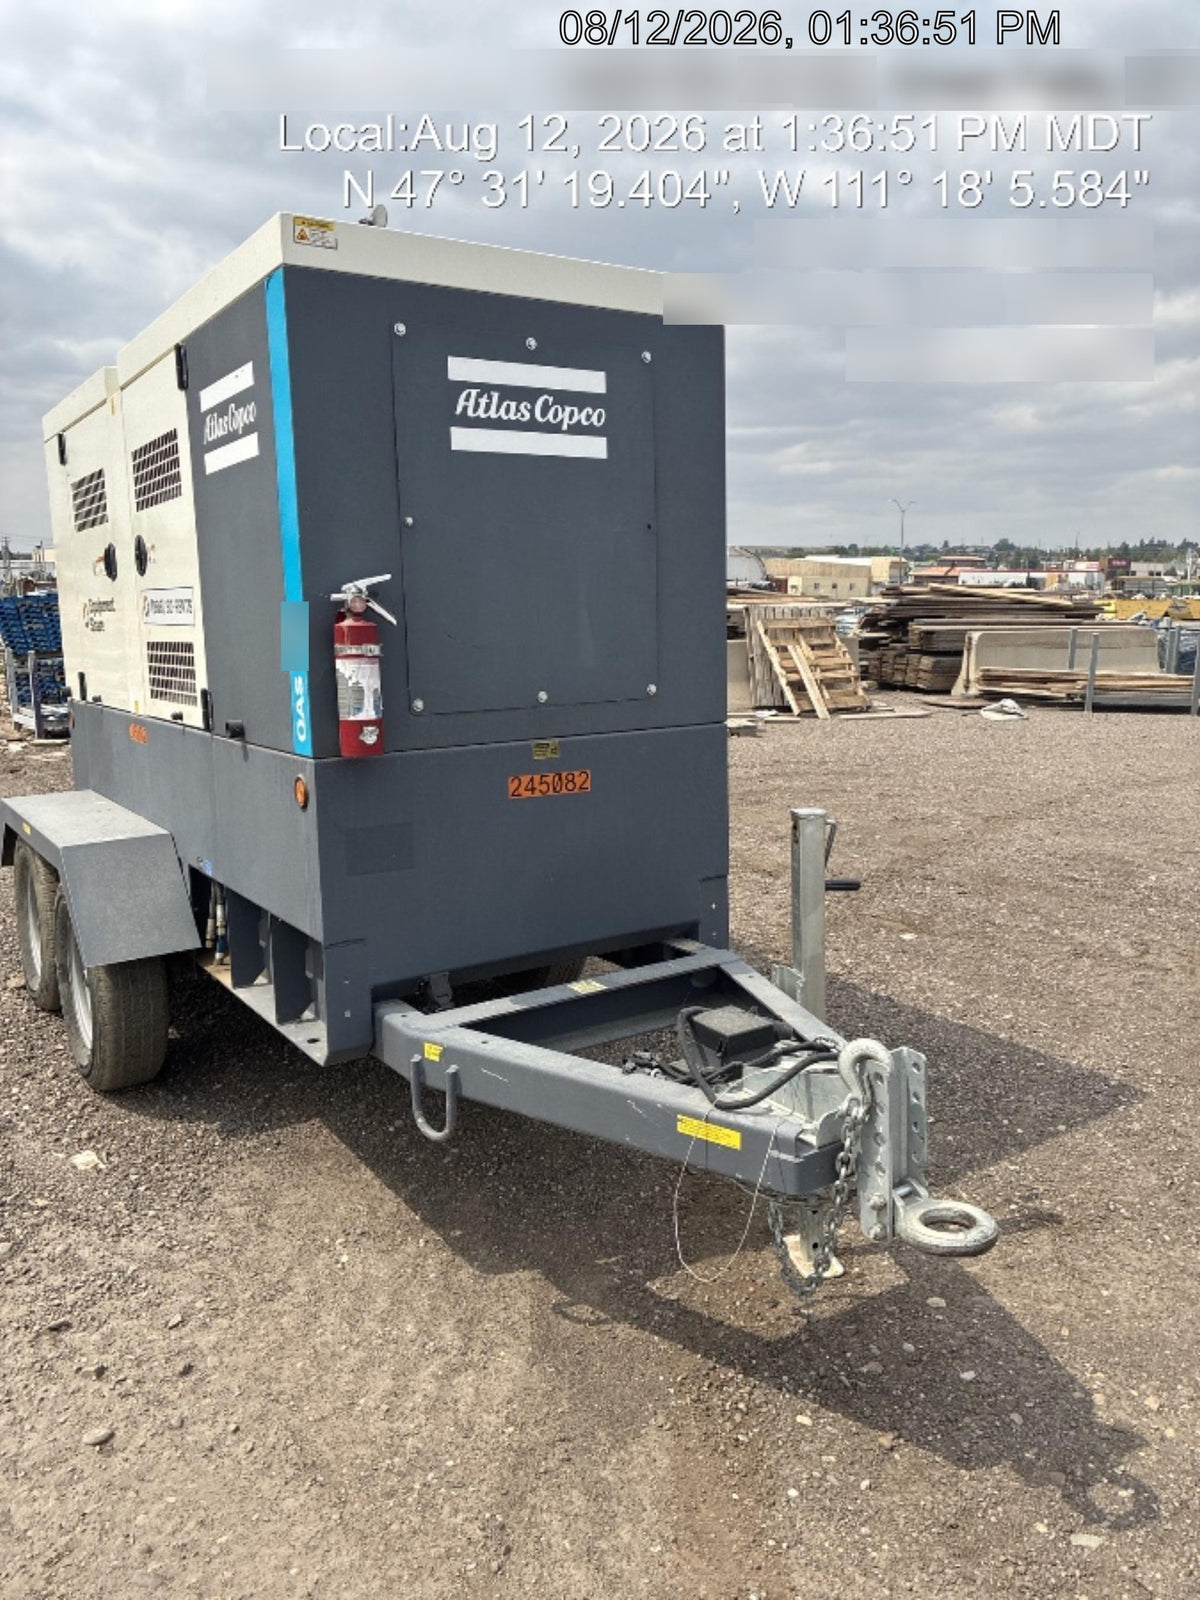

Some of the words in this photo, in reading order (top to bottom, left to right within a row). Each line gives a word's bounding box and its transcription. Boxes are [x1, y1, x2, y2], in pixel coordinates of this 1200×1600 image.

[203, 412, 229, 445] Atlas
[228, 402, 257, 435] Copco
[455, 388, 532, 422] Atlas
[534, 394, 606, 431] Copco
[509, 770, 590, 797] 245082
